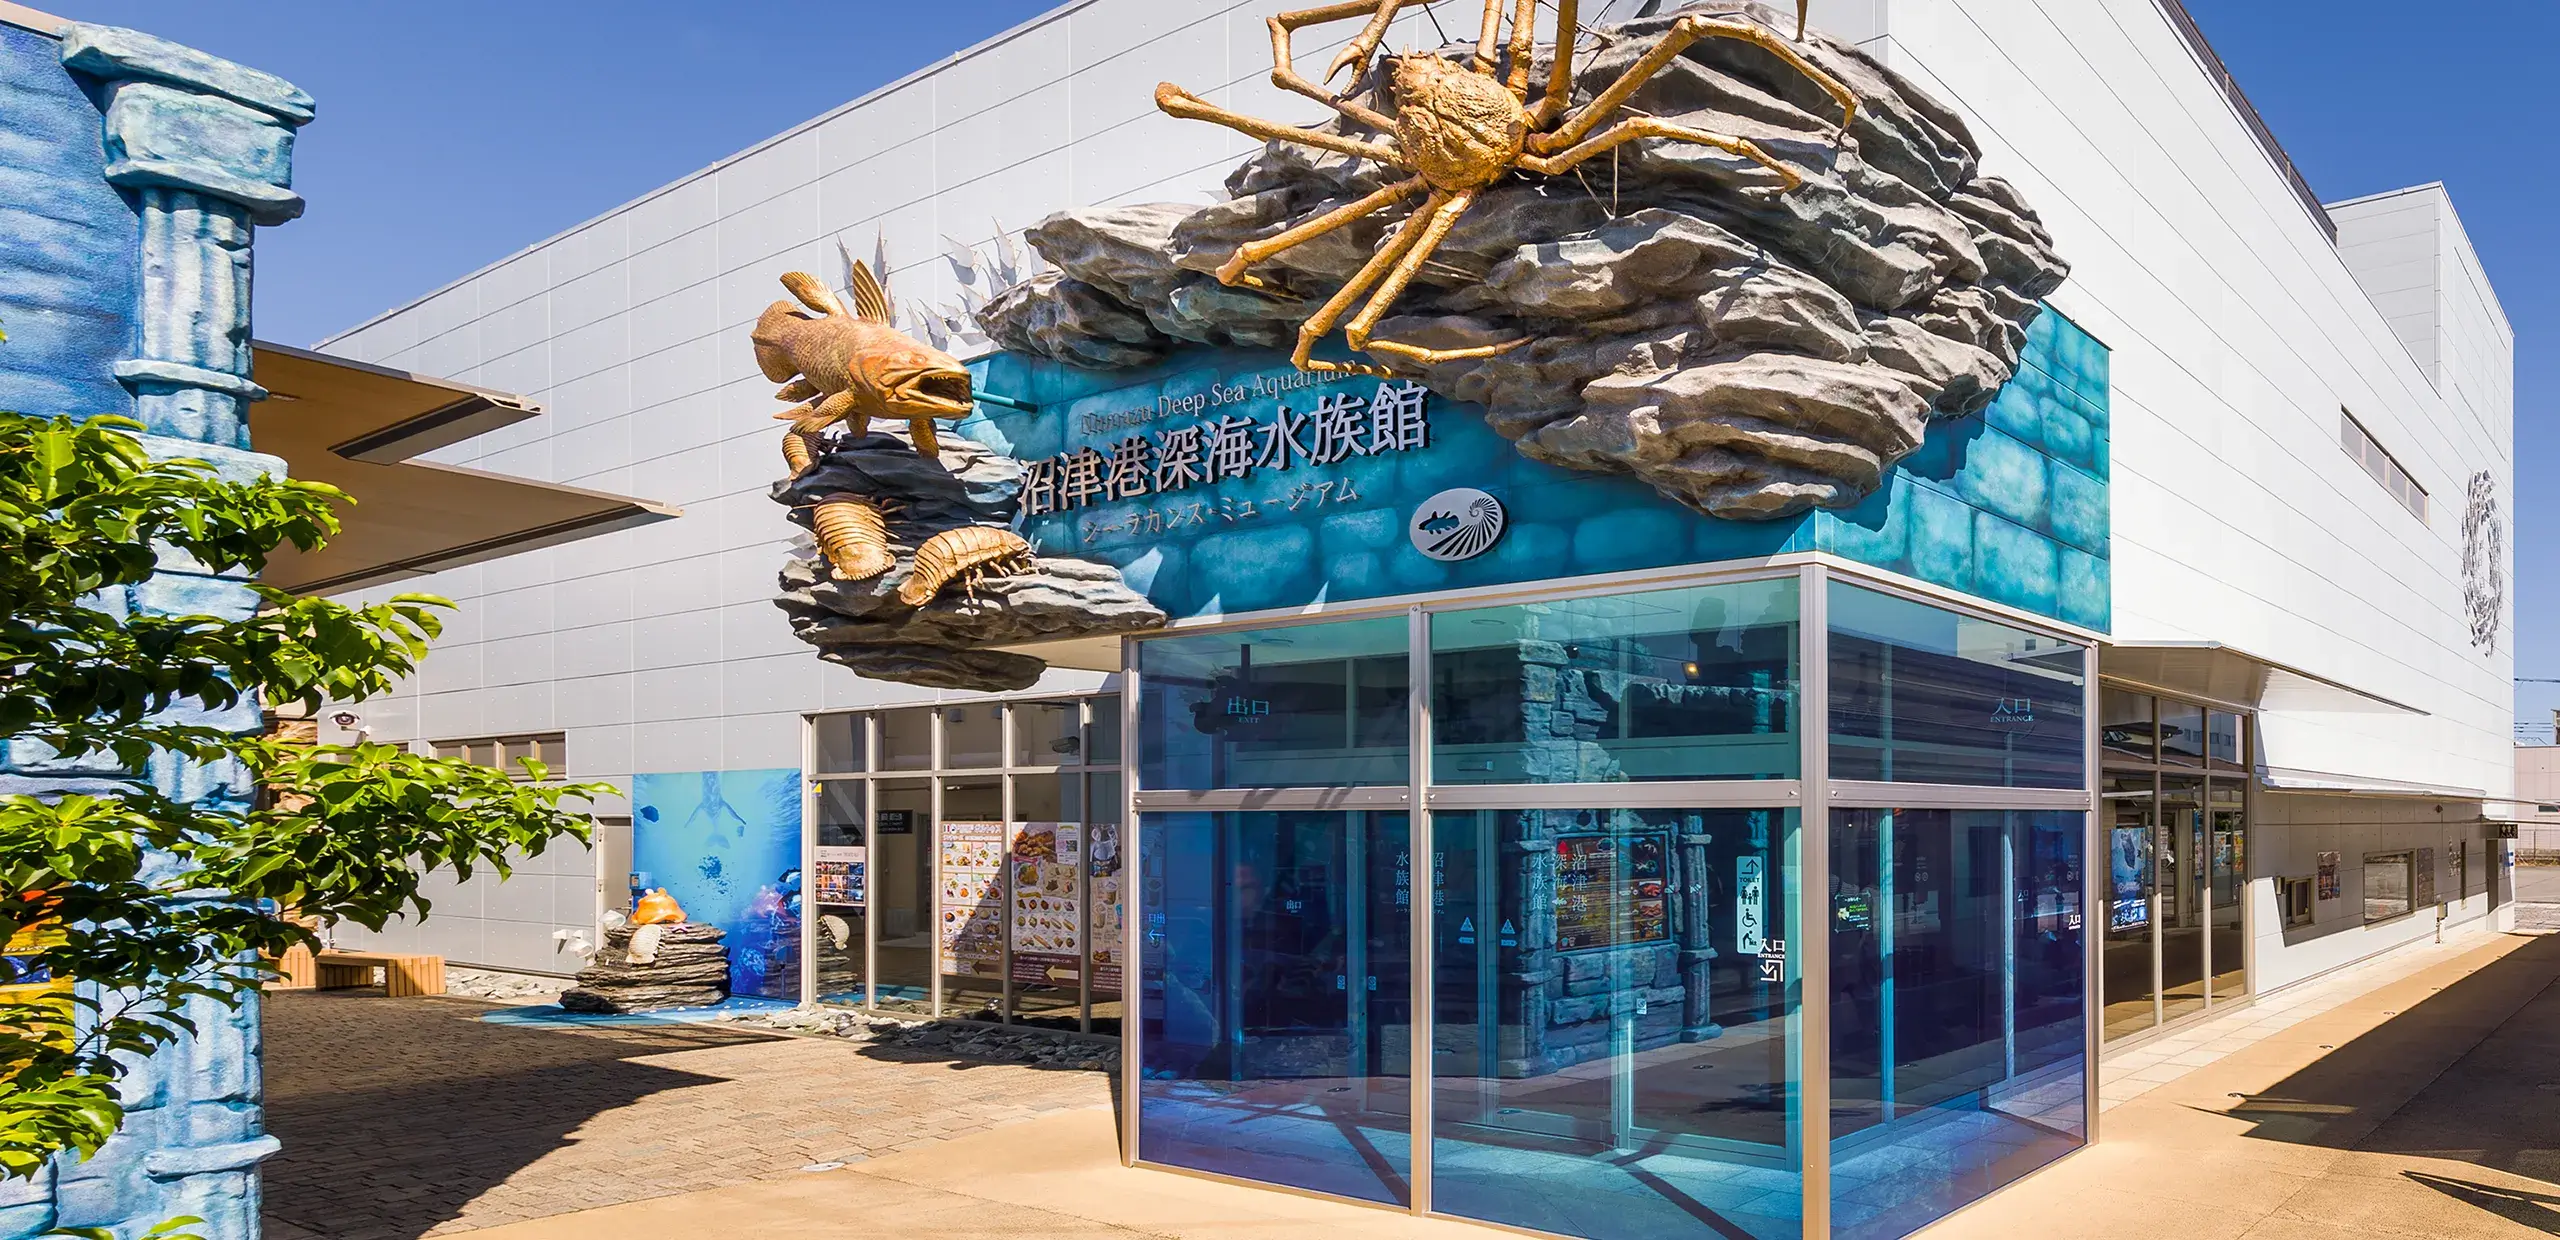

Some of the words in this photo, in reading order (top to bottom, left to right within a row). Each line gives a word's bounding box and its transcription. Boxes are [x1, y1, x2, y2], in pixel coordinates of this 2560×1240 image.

[1081, 405, 1153, 435] Numazu
[1158, 394, 1205, 418] Deep
[1211, 382, 1245, 407] Sea
[1017, 380, 1428, 516] 沼津港深海水族館
[1227, 696, 1269, 715] 出口
[1992, 697, 2031, 716] 入口
[1395, 851, 1410, 905] 水族館
[1532, 853, 1548, 910] 水族館
[1572, 853, 1587, 912] 沼津港
[1758, 938, 1786, 953] 入口
